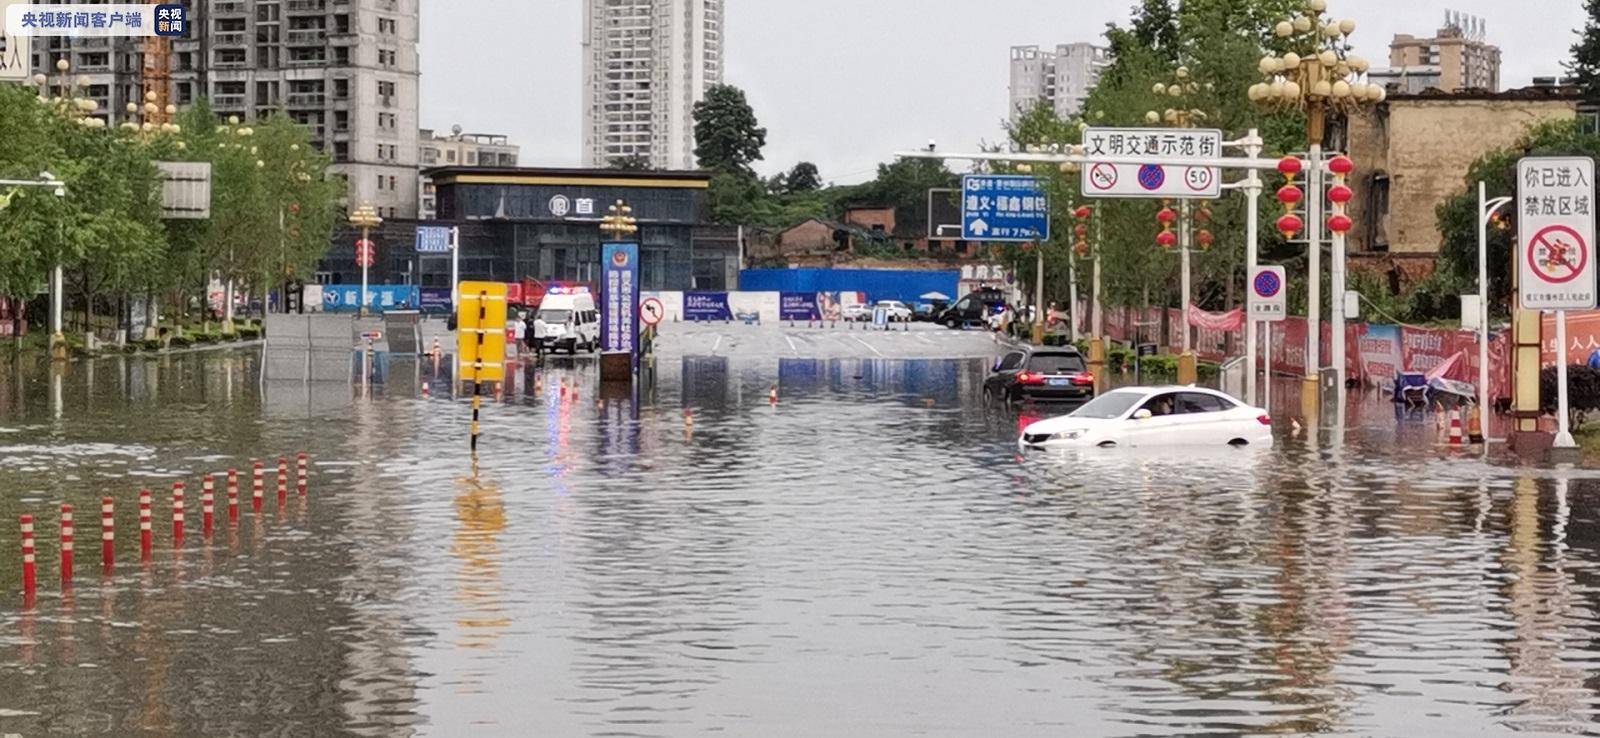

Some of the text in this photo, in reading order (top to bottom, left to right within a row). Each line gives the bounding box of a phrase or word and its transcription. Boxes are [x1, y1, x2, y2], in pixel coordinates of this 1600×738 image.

[1091, 135, 1215, 156] 文明交通示范街
[1190, 171, 1207, 183] 50
[1525, 167, 1588, 187] 你已进入
[1525, 195, 1589, 216] 禁放区域
